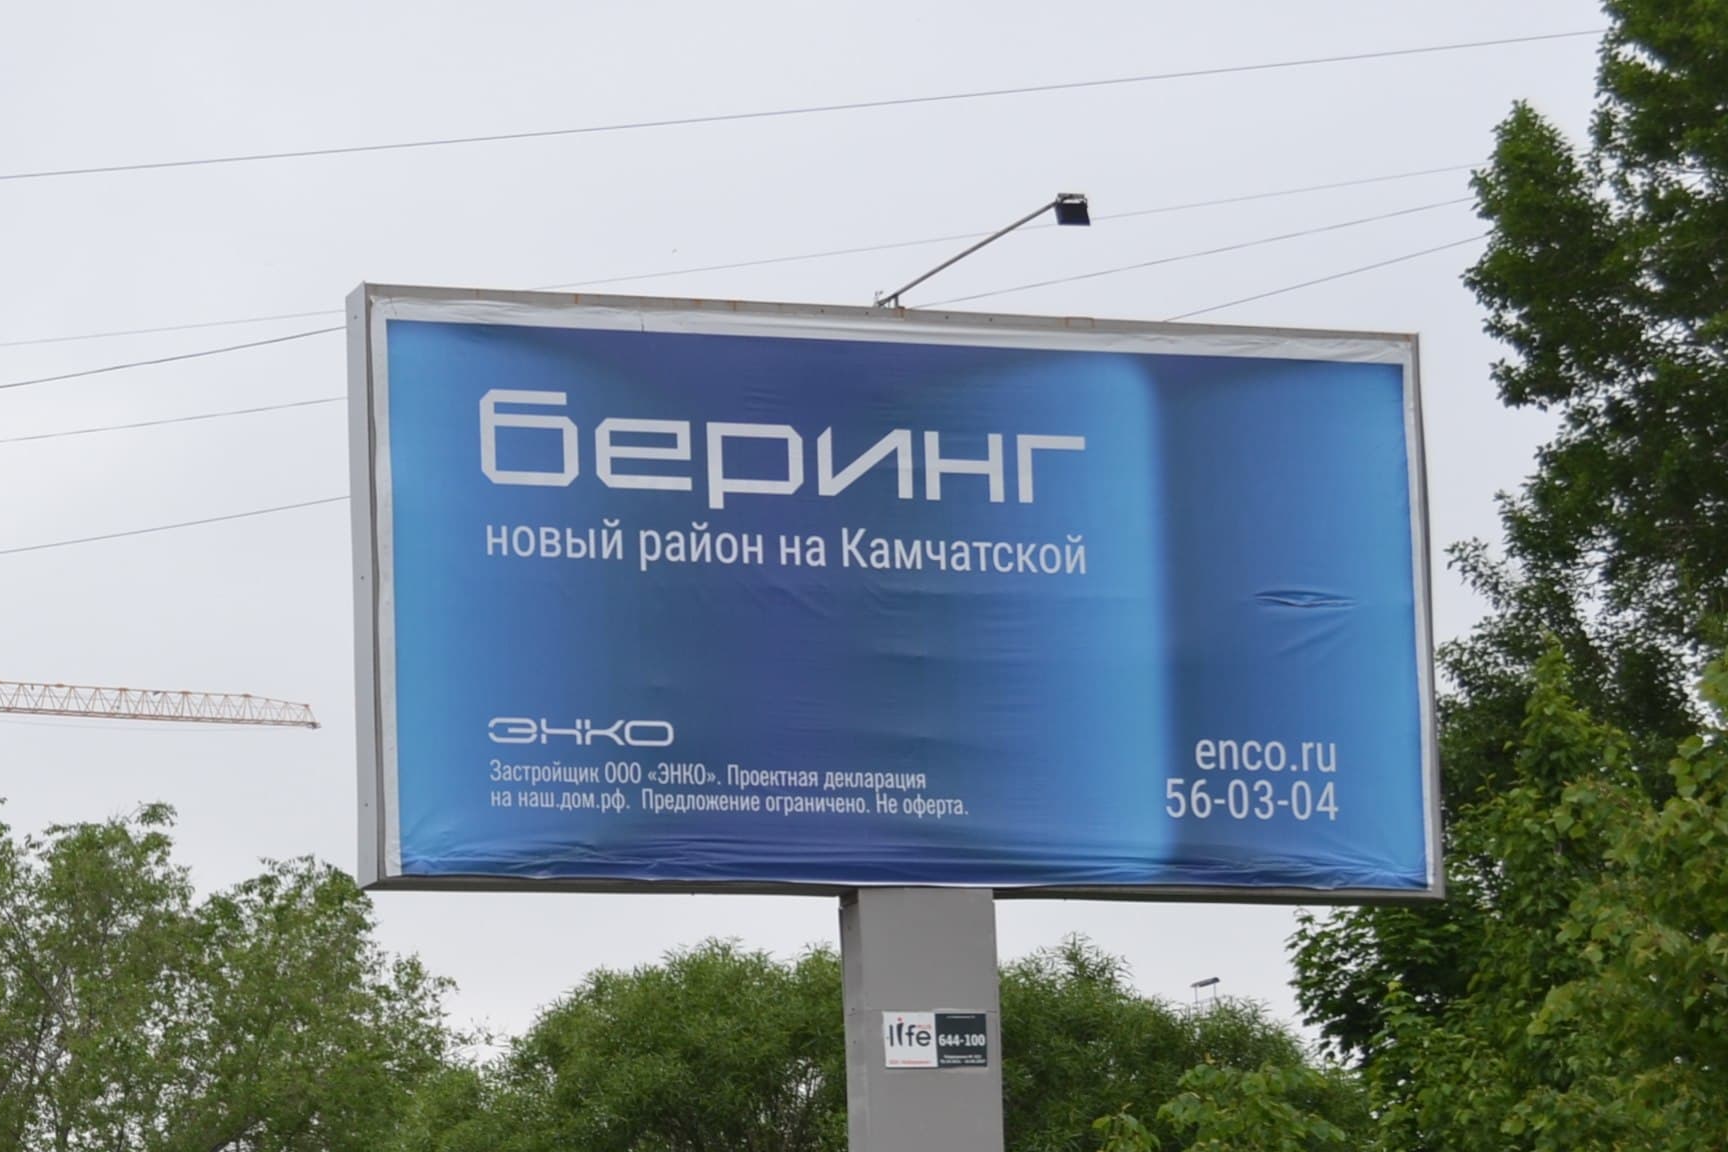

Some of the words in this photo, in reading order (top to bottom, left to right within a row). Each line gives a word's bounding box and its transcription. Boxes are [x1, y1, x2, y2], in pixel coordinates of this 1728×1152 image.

[479, 389, 1085, 509] беринг
[486, 518, 623, 561] новый
[639, 521, 764, 571] район
[779, 534, 827, 567] на
[841, 527, 1087, 575] Камчатской
[488, 717, 674, 747] ЭНКО
[1195, 738, 1336, 773] enco.ru
[489, 758, 600, 786] Застройщик
[604, 761, 642, 785] ООО
[647, 762, 722, 786] «ЭНКО».
[727, 764, 819, 790] Проектная
[824, 769, 927, 792] декларация
[490, 791, 512, 808] на
[641, 788, 761, 814] Предложение
[765, 794, 871, 817] ограничено.
[876, 792, 899, 815] Не
[903, 793, 969, 819] оферта.
[1165, 778, 1339, 821] 56-03-04
[889, 1016, 932, 1047] life
[938, 1033, 986, 1047] 644-100
